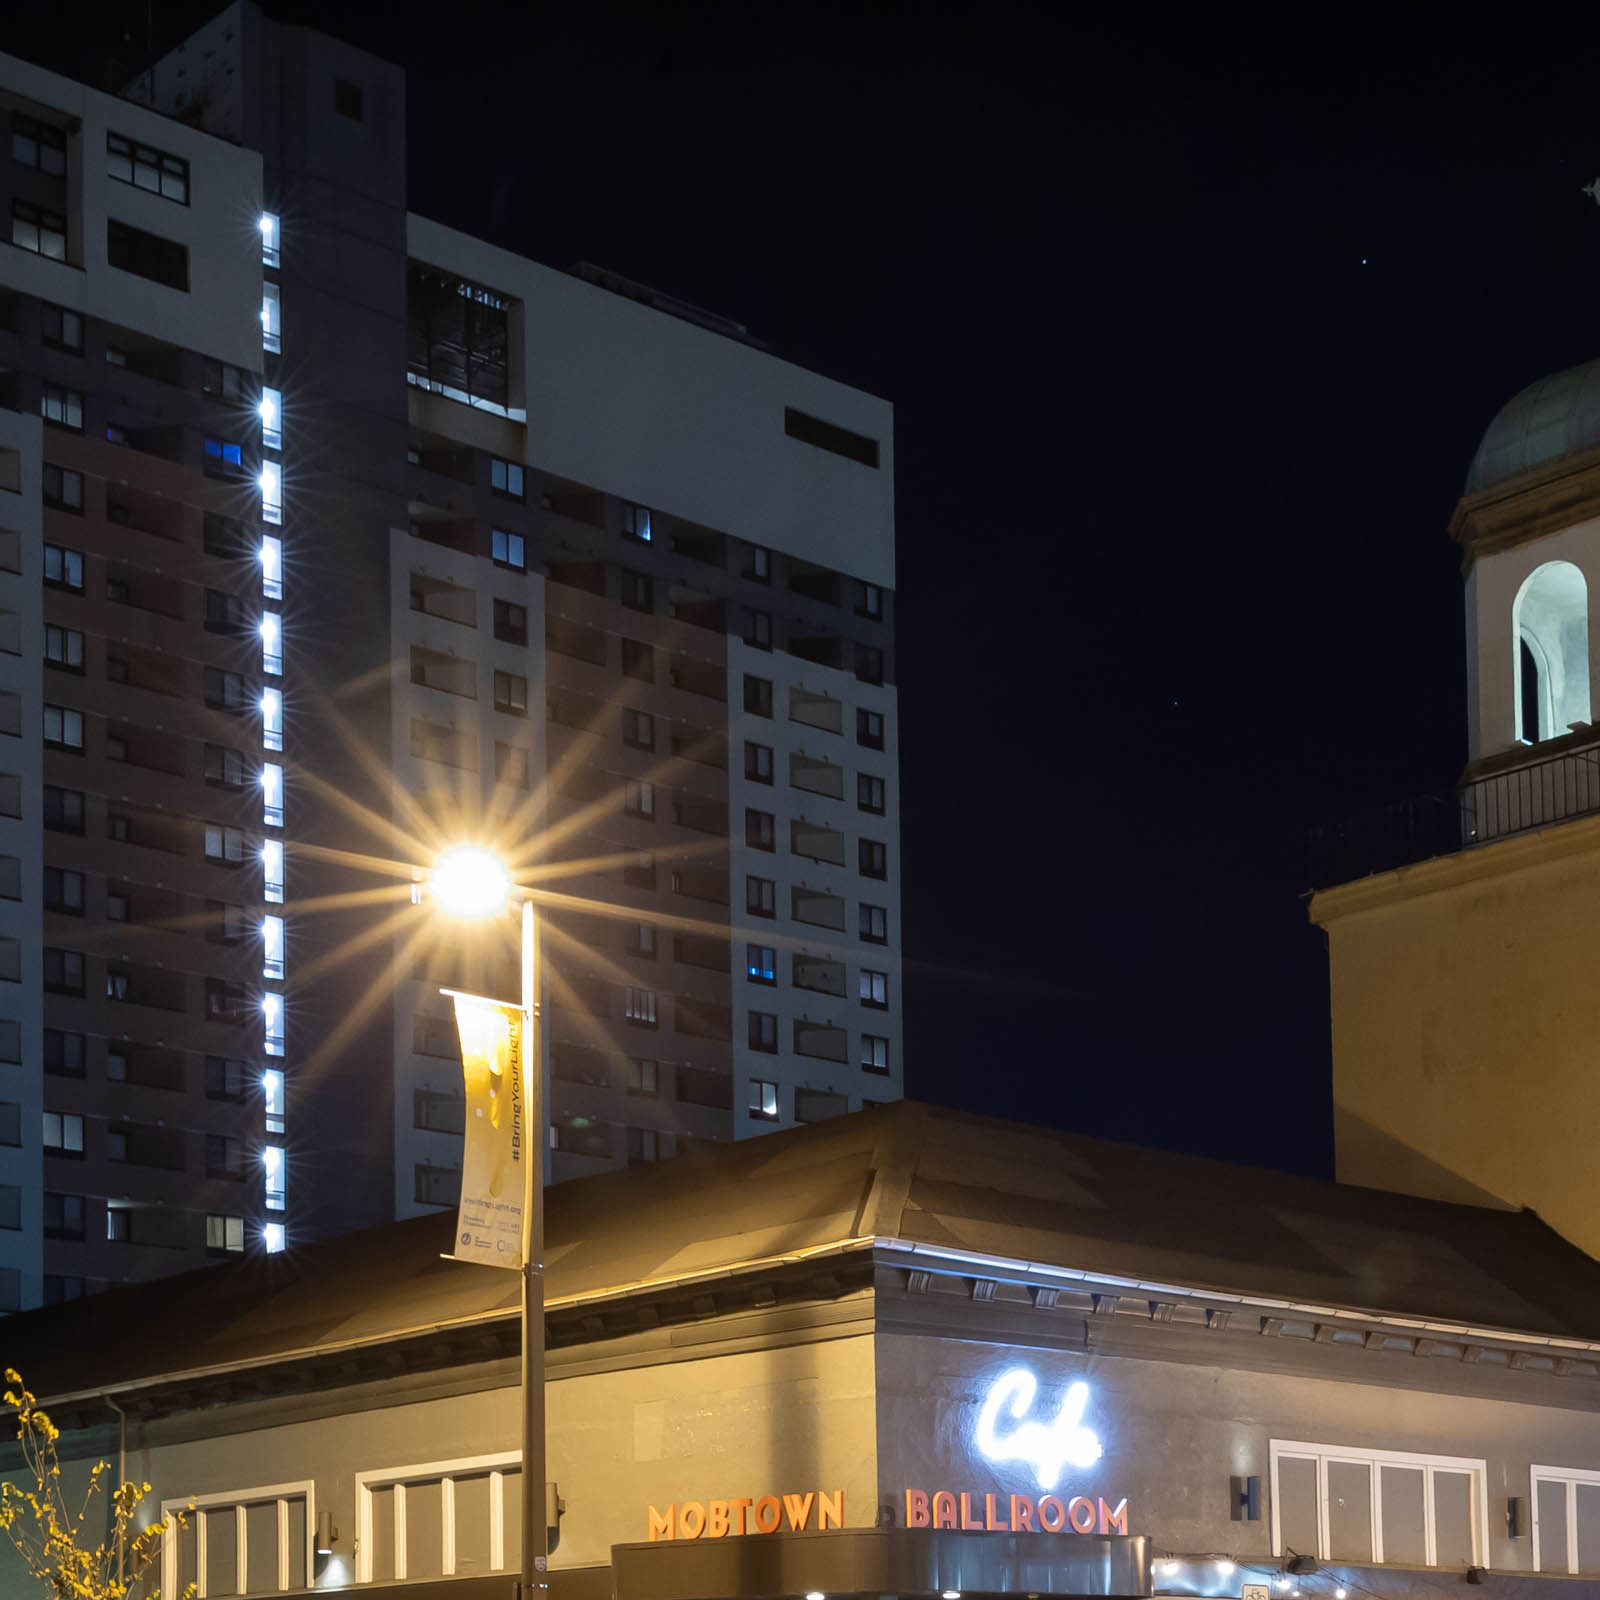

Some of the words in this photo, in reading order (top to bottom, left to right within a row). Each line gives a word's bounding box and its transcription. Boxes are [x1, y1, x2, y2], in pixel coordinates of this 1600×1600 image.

[508, 1021, 522, 1163] #BringYourLight
[647, 1489, 844, 1543] MOBTOWN
[905, 1488, 1129, 1536] BALLROOM
